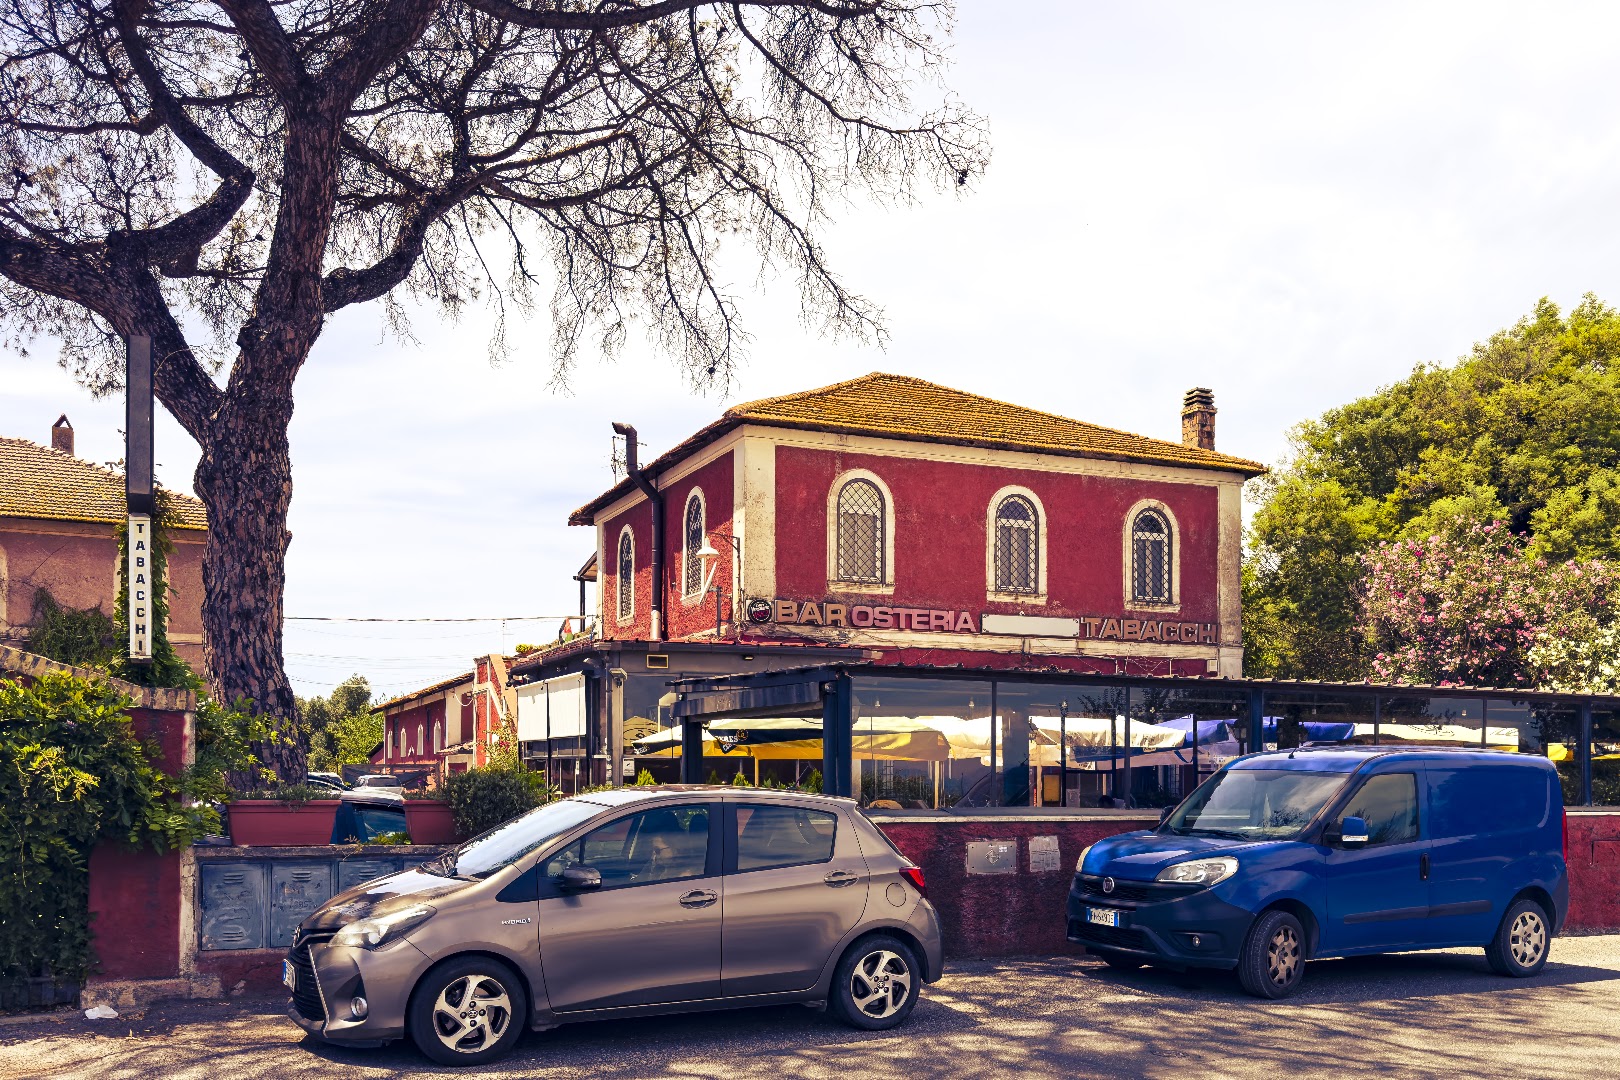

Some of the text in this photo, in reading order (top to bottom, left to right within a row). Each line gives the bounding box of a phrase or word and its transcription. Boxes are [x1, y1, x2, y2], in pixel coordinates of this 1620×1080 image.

[135, 523, 146, 651] TABACCHI
[775, 600, 847, 626] BAR
[851, 605, 977, 632] OSTERIA
